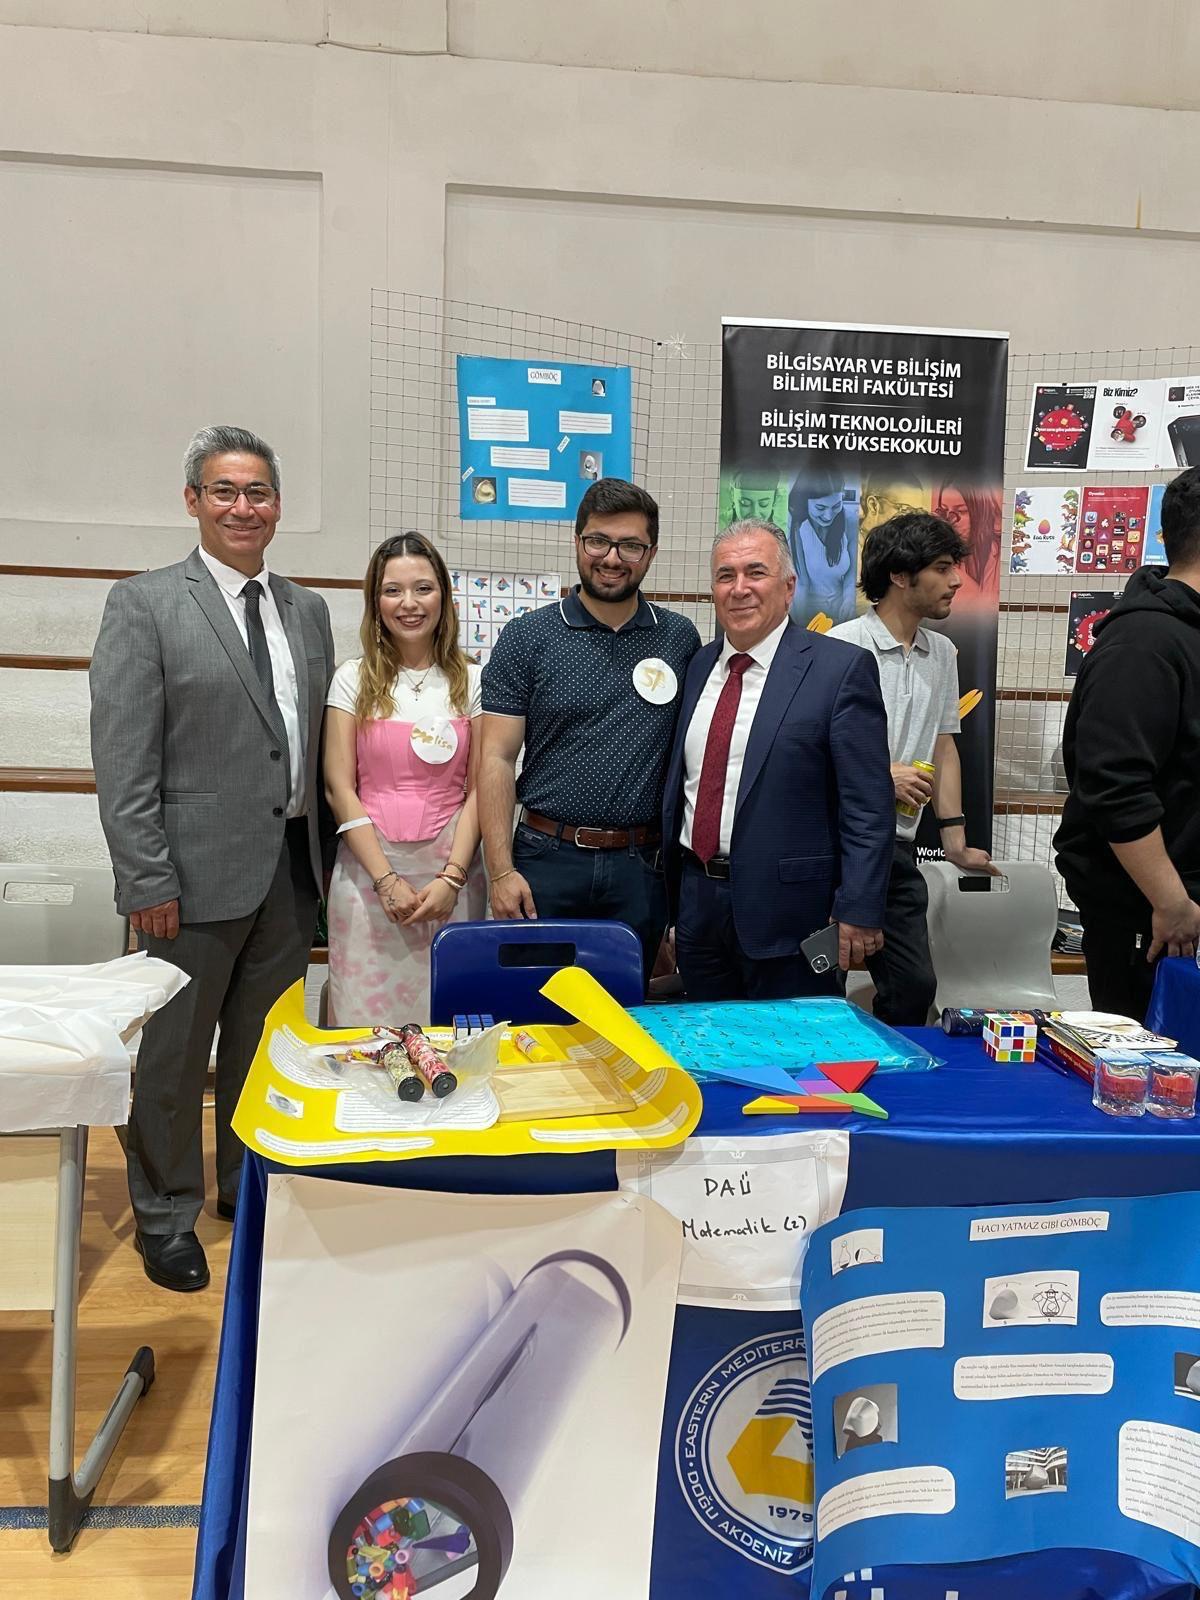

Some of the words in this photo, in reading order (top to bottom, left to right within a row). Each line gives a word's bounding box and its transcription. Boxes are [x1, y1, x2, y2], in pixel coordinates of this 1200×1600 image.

[766, 352, 867, 373] BİLGİSAYAR
[871, 359, 893, 374] VE
[897, 358, 961, 380] BİLİŞİM
[773, 373, 859, 393] BİLİMLERİ
[863, 378, 954, 398] FAKÜLTESİ
[1103, 387, 1114, 397] Biz
[1115, 387, 1138, 397] Kimiz?
[761, 409, 826, 431] BİLİŞİM
[830, 415, 962, 435] TEKNOLOJİLERİ
[760, 432, 829, 449] MESLEK
[833, 433, 962, 456] YÜKSEKOKULU
[704, 1170, 751, 1197] DAÜ
[682, 1217, 776, 1240] Matematik
[784, 1215, 807, 1231] (2)
[977, 1223, 1000, 1233] HACI
[1002, 1220, 1039, 1231] YATMAZ
[1060, 1216, 1102, 1228] GÖMBÖÇ
[685, 1380, 720, 1458] EASTERN
[687, 1470, 719, 1520] DOĞU
[718, 1520, 794, 1565] AKDENİZ
[768, 1504, 814, 1523] 1979
